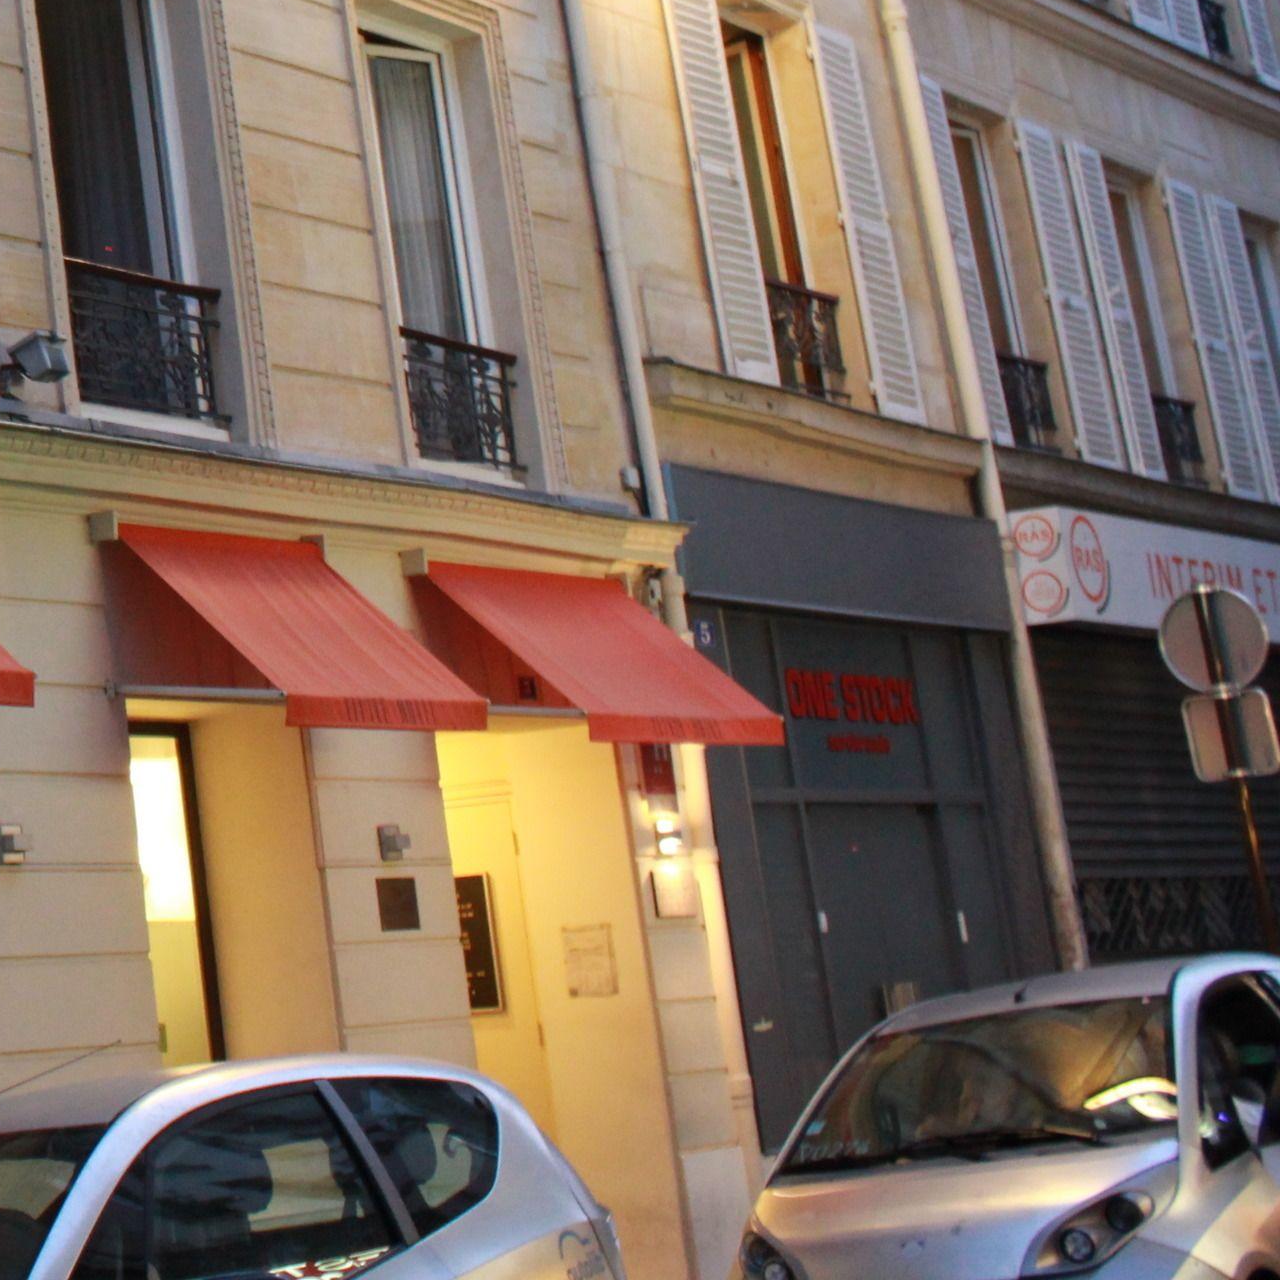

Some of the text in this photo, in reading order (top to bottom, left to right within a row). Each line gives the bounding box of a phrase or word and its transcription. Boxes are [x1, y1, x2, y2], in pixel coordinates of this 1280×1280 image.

[1018, 530, 1051, 543] RAS
[1072, 546, 1105, 572] RAS
[1252, 568, 1278, 615] ET
[699, 622, 711, 644] 5
[785, 668, 919, 726] ONE STOCK
